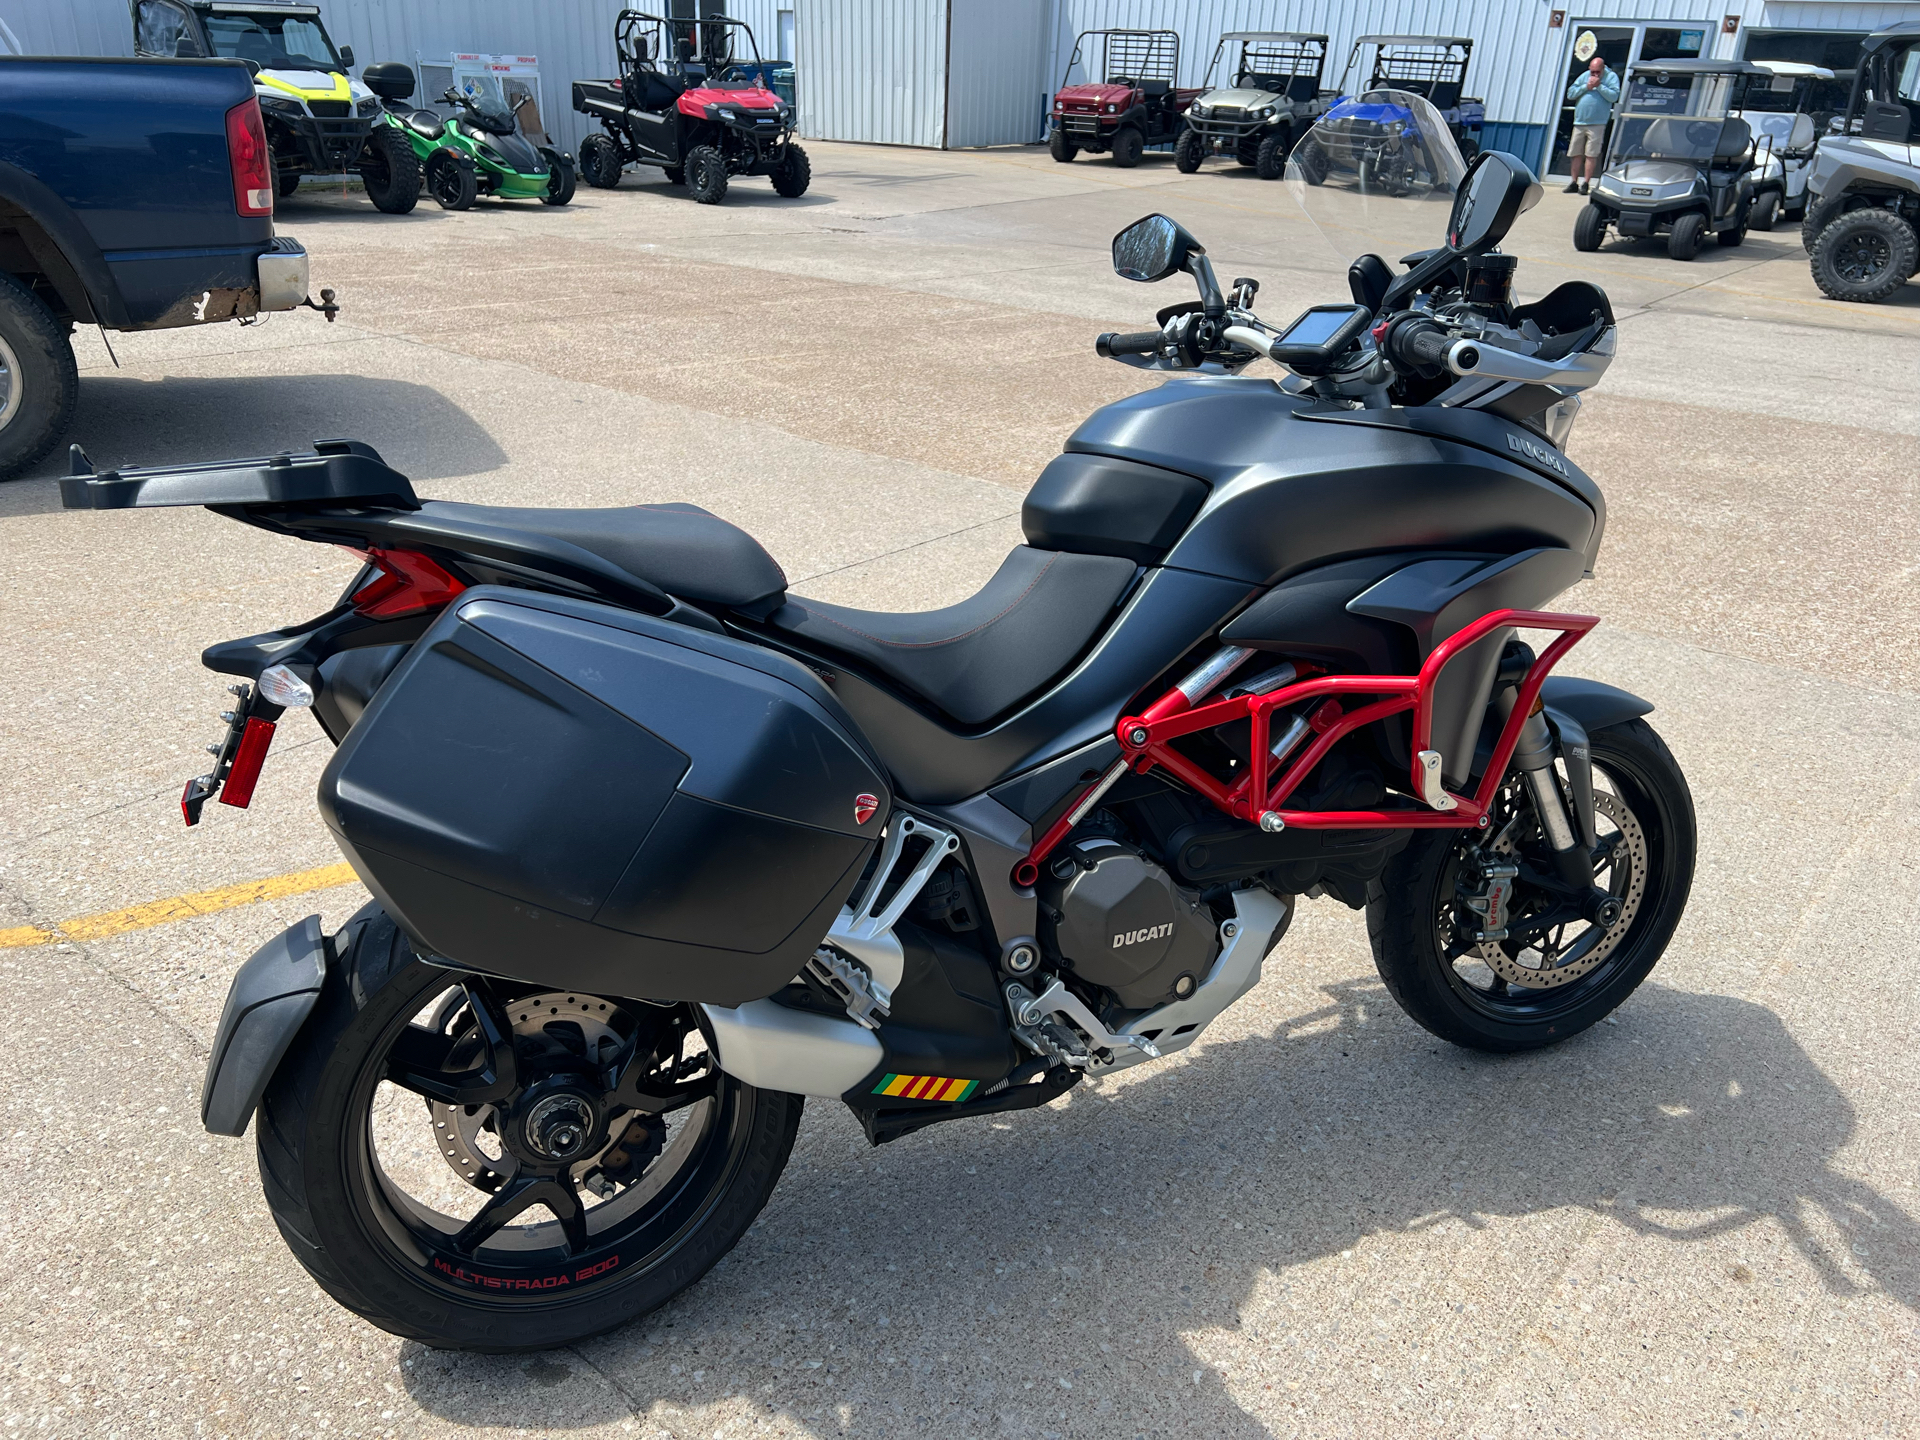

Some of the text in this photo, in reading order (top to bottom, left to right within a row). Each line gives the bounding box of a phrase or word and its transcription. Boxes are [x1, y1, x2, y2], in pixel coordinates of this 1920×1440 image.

[1506, 433, 1570, 478] DUCATI
[1488, 886, 1502, 926] brembo
[1112, 922, 1174, 949] DUCATI
[434, 1254, 620, 1290] MULTISTRADA 1200
